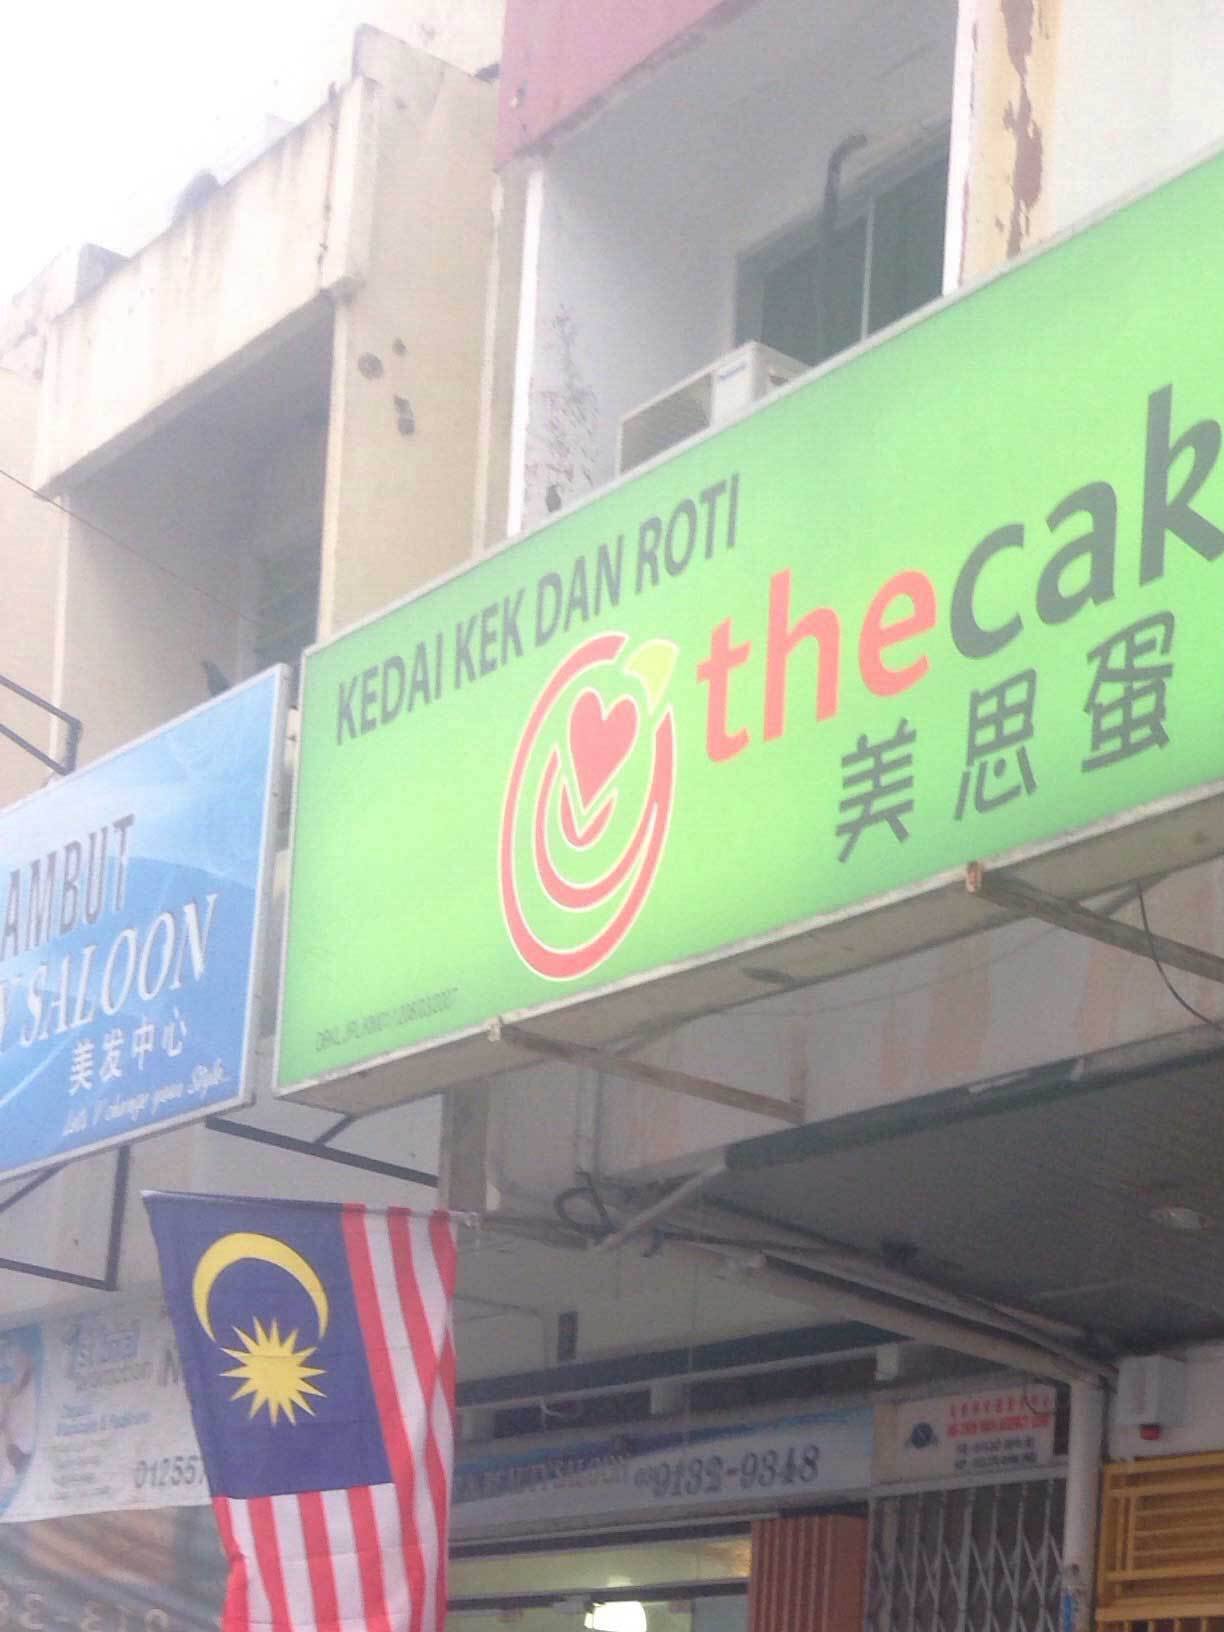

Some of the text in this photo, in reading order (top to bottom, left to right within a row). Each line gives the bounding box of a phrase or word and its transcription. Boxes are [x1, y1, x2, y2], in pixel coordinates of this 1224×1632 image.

[336, 473, 740, 746] KEDAI KEK DAN ROTI
[18, 893, 219, 1048] SALOON
[69, 1004, 188, 1096] 美发中心
[134, 1454, 206, 1488] 01255
